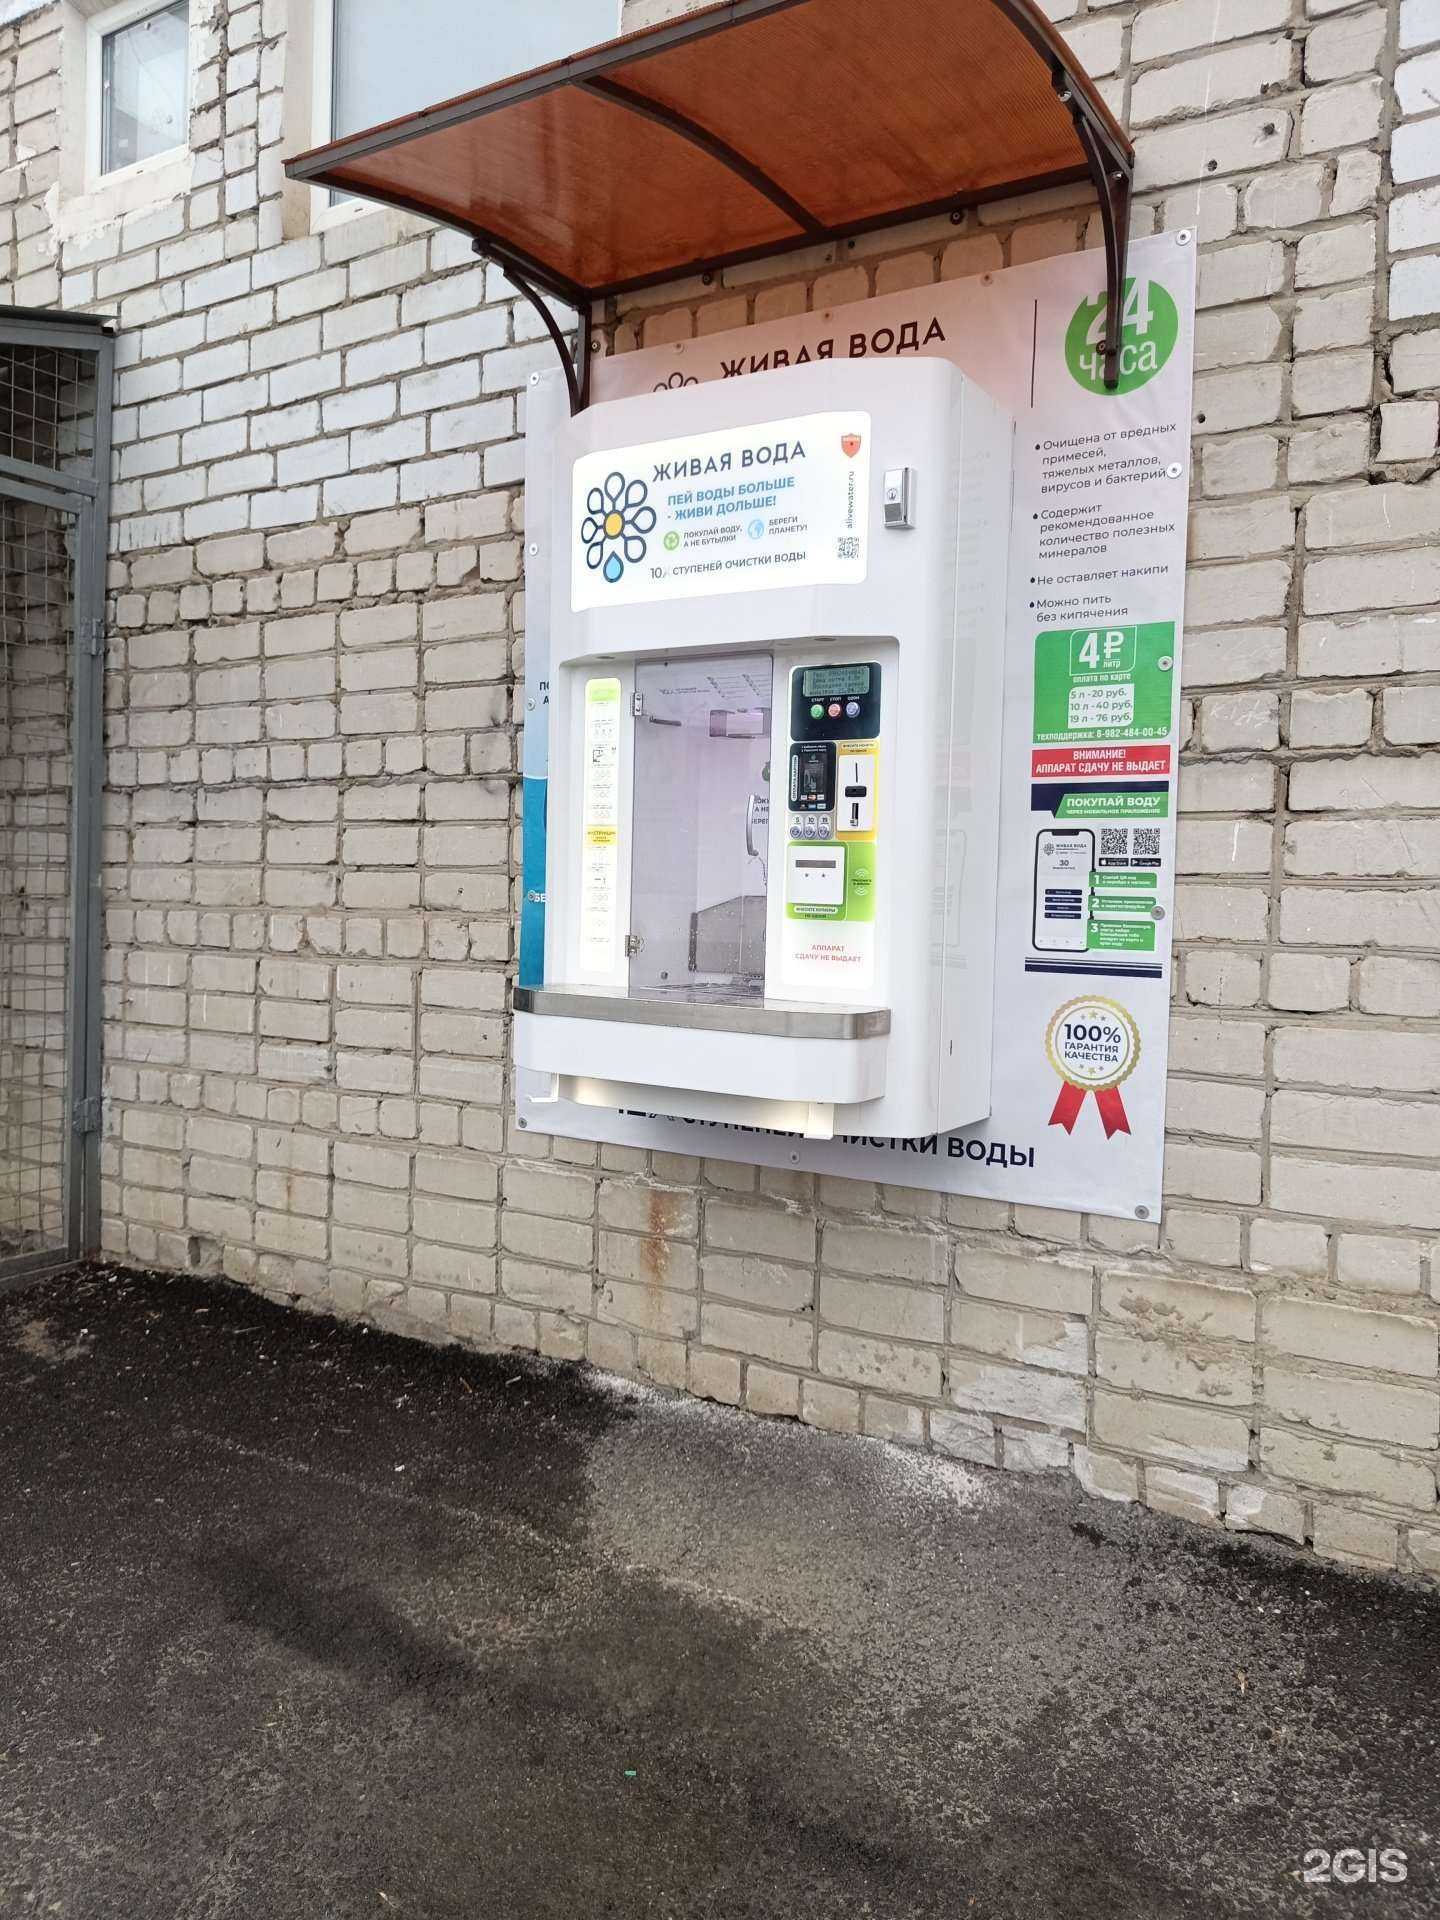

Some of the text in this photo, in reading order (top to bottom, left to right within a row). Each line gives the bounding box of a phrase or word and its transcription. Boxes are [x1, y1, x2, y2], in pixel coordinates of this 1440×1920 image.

[720, 316, 946, 378] ЖИВАЯ ВОДА
[1080, 340, 1158, 380] чса
[1042, 423, 1177, 450] Очищена от вредных
[652, 440, 806, 482] ЖИВАЯ ВОДА
[1042, 448, 1107, 466] примесей,
[1042, 456, 1161, 479] тяжелых металлов,
[1041, 468, 1166, 495] вирусов и бактерий
[667, 476, 795, 506] ПЕЙ ВОДЫ БОЛЬШЕ
[675, 505, 713, 521] ЖИВИ
[716, 495, 777, 515] ДОЛЬШЕ!
[1040, 504, 1102, 521] Содержит
[768, 516, 798, 526] БЕРЕГИ
[1040, 511, 1154, 534] рекомендованное
[683, 525, 719, 539] ПОКУПАЙ
[768, 524, 808, 535] ПЛАНЕТУ!
[1039, 523, 1175, 547] количество полезных
[683, 534, 737, 548] А НЕ БУТЫЛКИ
[1038, 545, 1107, 559] минералов
[672, 560, 723, 577] СТУПЕНЕЙ
[724, 555, 772, 570] ОЧИСТКИ
[774, 551, 806, 563] ВОДЫ
[1037, 564, 1169, 585] Не оставляет накипи
[1036, 595, 1112, 609] Можно пить
[1036, 607, 1128, 623] без кипячения
[1073, 675, 1098, 684] оплата
[1070, 691, 1077, 699] 5
[1105, 687, 1128, 701] руб.
[1070, 703, 1080, 711] 10
[1110, 711, 1132, 726] руб.
[1073, 749, 1126, 760] ВНИМАНИЕ!
[1035, 760, 1166, 773] АППАРАТ СДАЧУ НЕ ВЫДАЕТ
[1066, 795, 1161, 808] ПОКУПАЙ ВОДУ
[1094, 875, 1100, 885] 1
[1091, 898, 1100, 908] 2
[1090, 923, 1099, 933] 3
[811, 944, 845, 952] АППАРАТ
[794, 952, 819, 961] СДАЧУ
[831, 954, 862, 963] ВЫДАЕТ
[1064, 1023, 1122, 1044] 100%
[1064, 1041, 1119, 1054] ГАРАНТИЯ
[1064, 1051, 1119, 1063] КАЧЕСТВА
[947, 1136, 1035, 1169] ВОДЫ
